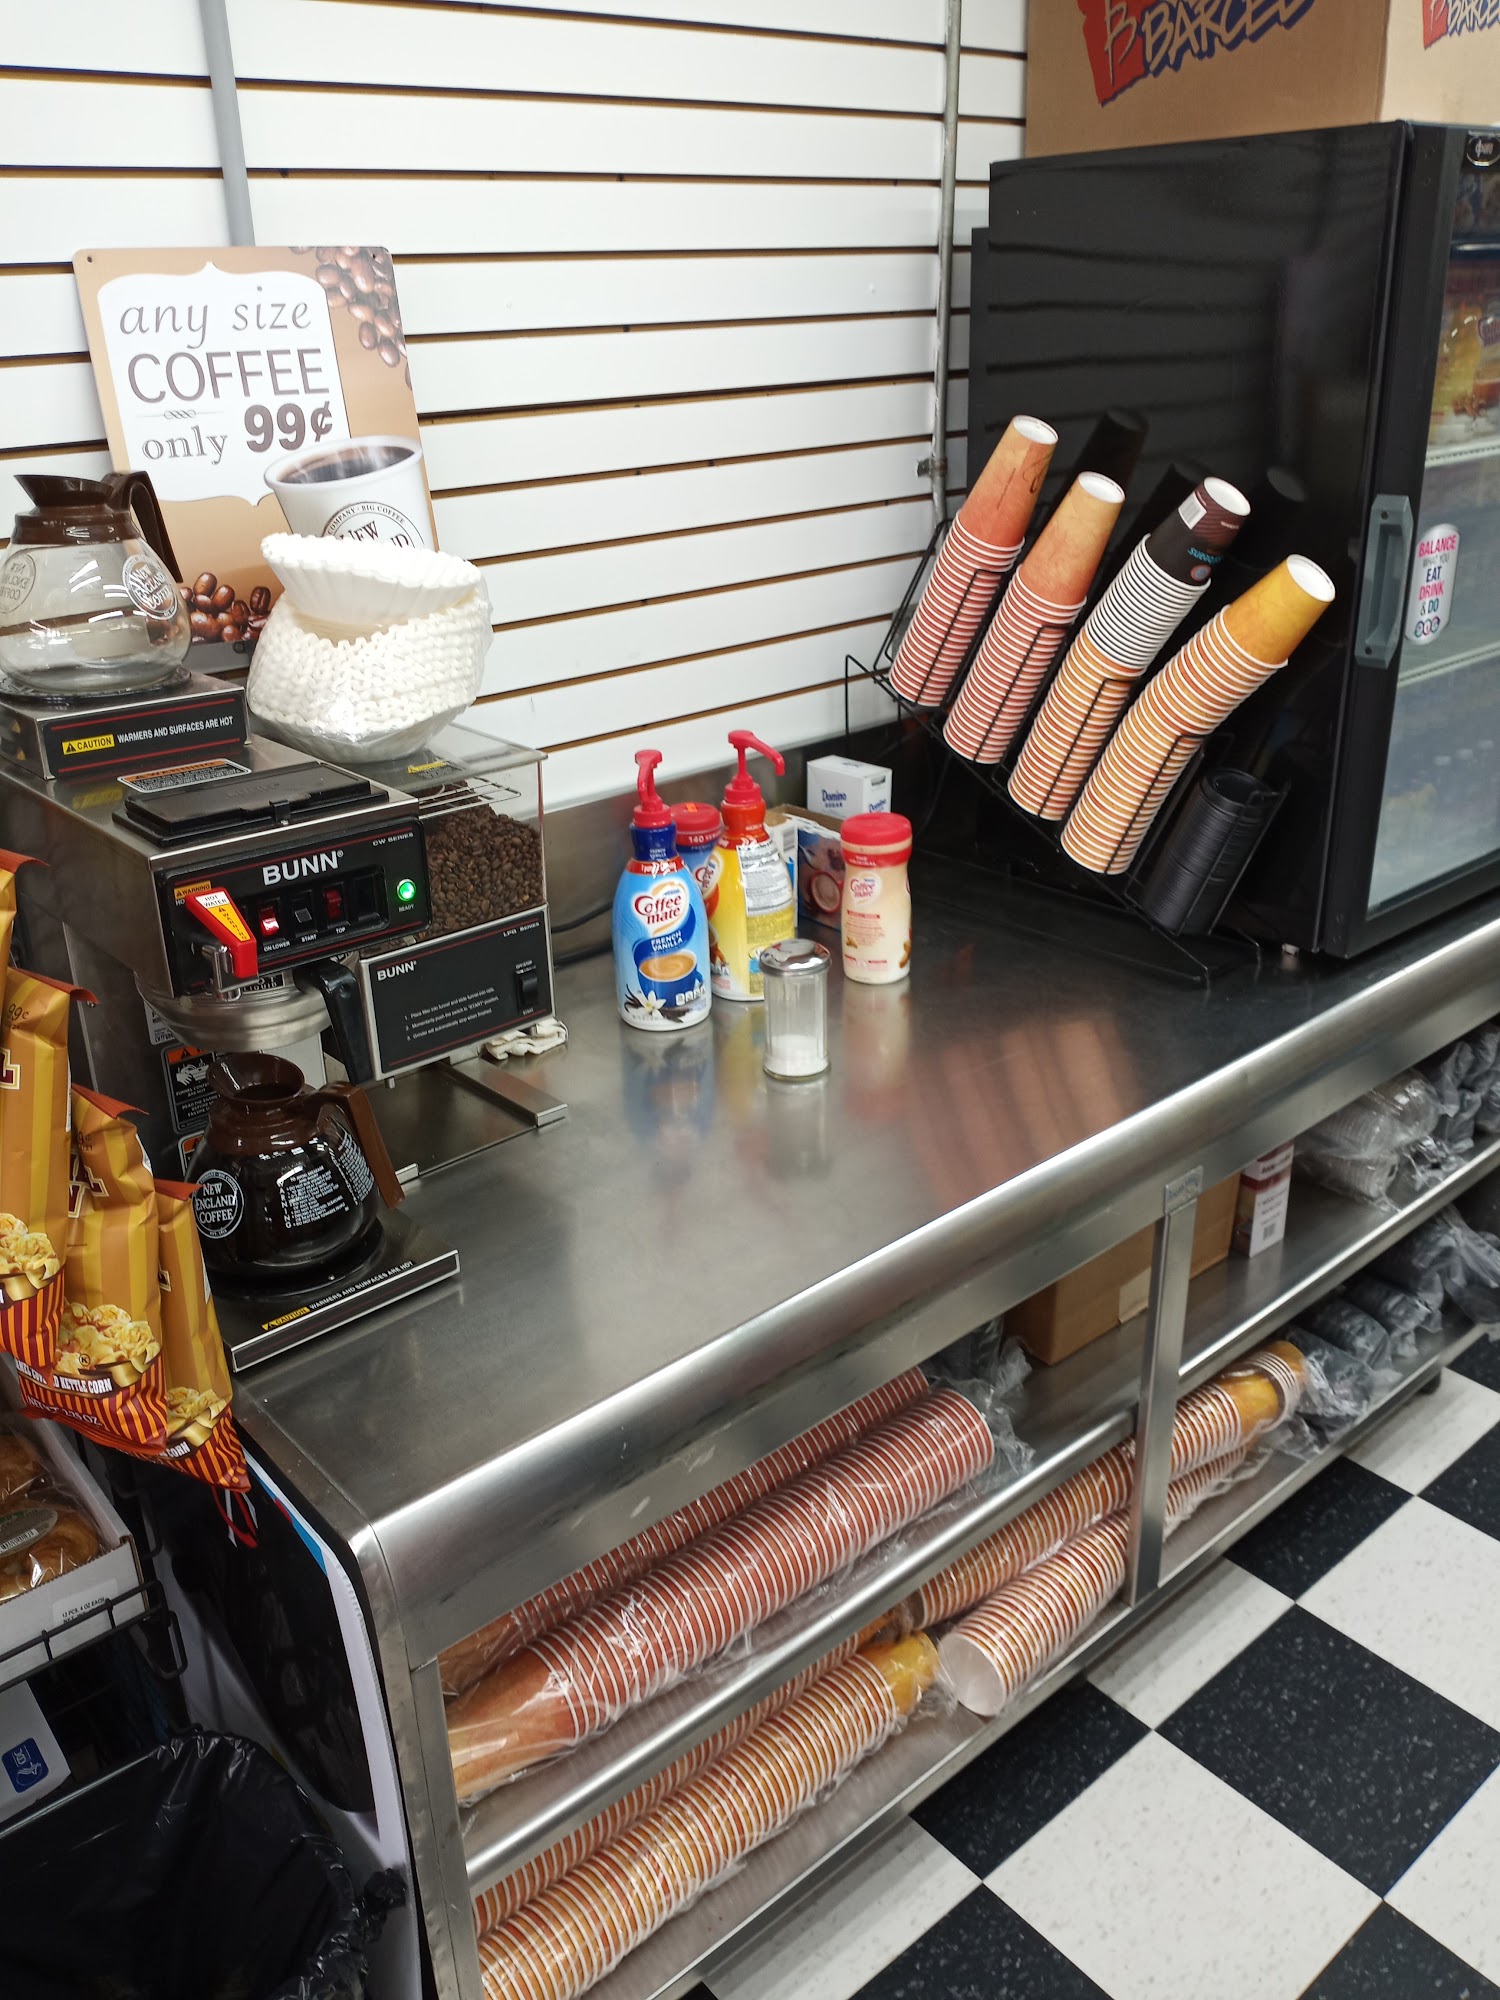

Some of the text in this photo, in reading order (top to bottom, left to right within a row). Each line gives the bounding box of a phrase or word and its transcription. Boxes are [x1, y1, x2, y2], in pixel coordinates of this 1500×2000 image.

[119, 285, 312, 350] any size
[127, 348, 330, 404] COFFEE
[142, 400, 334, 466] only 99¢
[1418, 534, 1458, 558] BALANCE
[1426, 566, 1442, 582] EAT
[1419, 580, 1444, 601] DRINK
[1427, 598, 1440, 614] DO
[77, 715, 233, 751] CAUTION WARMERS AND SURFACES ARE HOT
[821, 788, 847, 803] Domino
[688, 835, 705, 844] 140
[182, 884, 210, 895] WARNING
[204, 898, 227, 908] WATER
[634, 894, 682, 917] Coffee
[647, 907, 681, 925] mate
[301, 934, 317, 943] START
[335, 926, 346, 935] TOP
[650, 930, 682, 946] FRENCH
[272, 940, 291, 951] LOWER
[652, 937, 683, 952] VANILLA
[202, 1182, 223, 1197] NEW
[195, 1194, 237, 1211] ENGLAND
[199, 1208, 234, 1224] COFFEE
[274, 1260, 414, 1325] CAUTION WARMERS AND SURFACES ARE HOT
[60, 1376, 89, 1394] KETTLE
[88, 1378, 113, 1395] CORN
[91, 1597, 105, 1607] EACH
